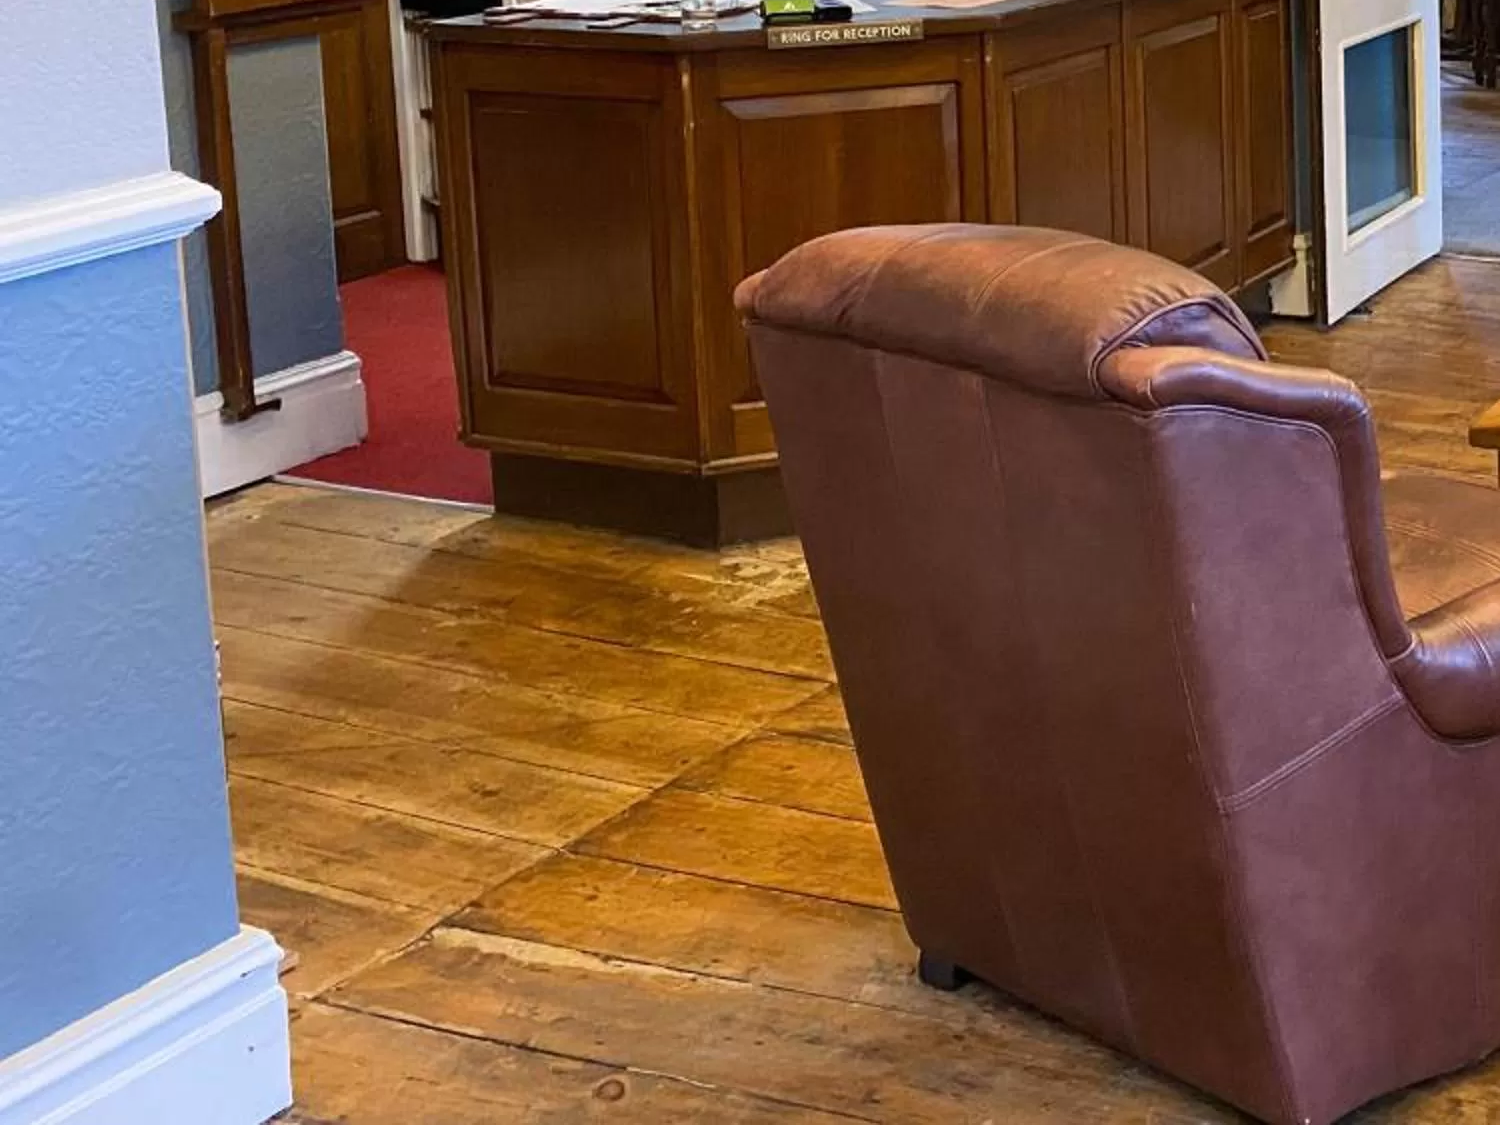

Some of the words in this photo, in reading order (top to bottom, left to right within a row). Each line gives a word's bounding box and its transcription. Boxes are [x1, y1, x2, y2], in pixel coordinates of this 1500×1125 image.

[780, 31, 811, 44] RING
[815, 29, 840, 42] FOR
[843, 25, 911, 40] RECEPTION
